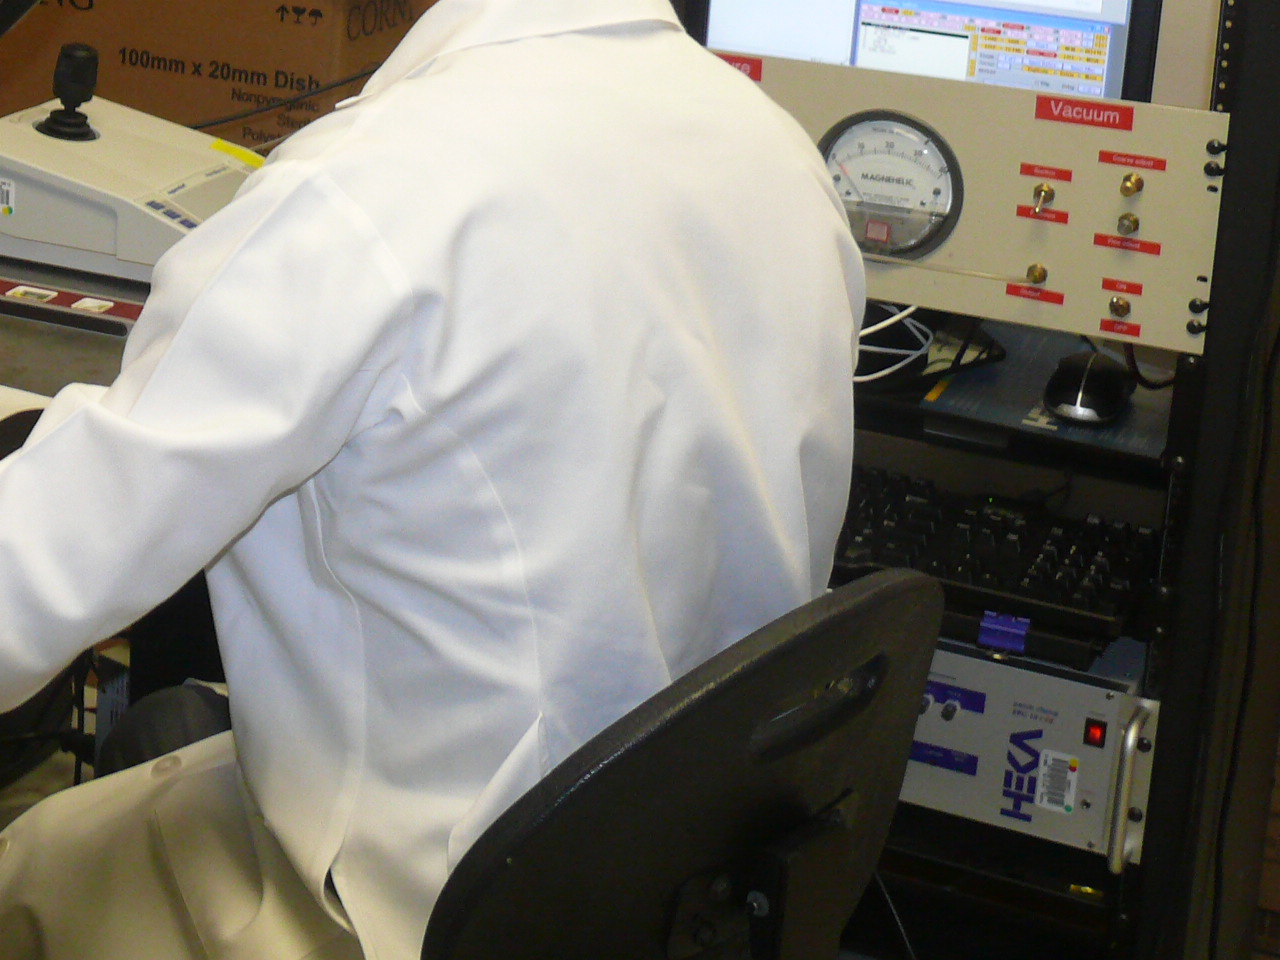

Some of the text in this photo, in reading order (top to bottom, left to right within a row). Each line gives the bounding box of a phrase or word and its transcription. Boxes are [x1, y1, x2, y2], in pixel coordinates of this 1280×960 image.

[119, 47, 320, 92] 100mm x 20mm Dish
[1050, 99, 1120, 125] Vacuum
[860, 172, 913, 186] MAGNEHELIC
[1000, 728, 1043, 823] HEKA
